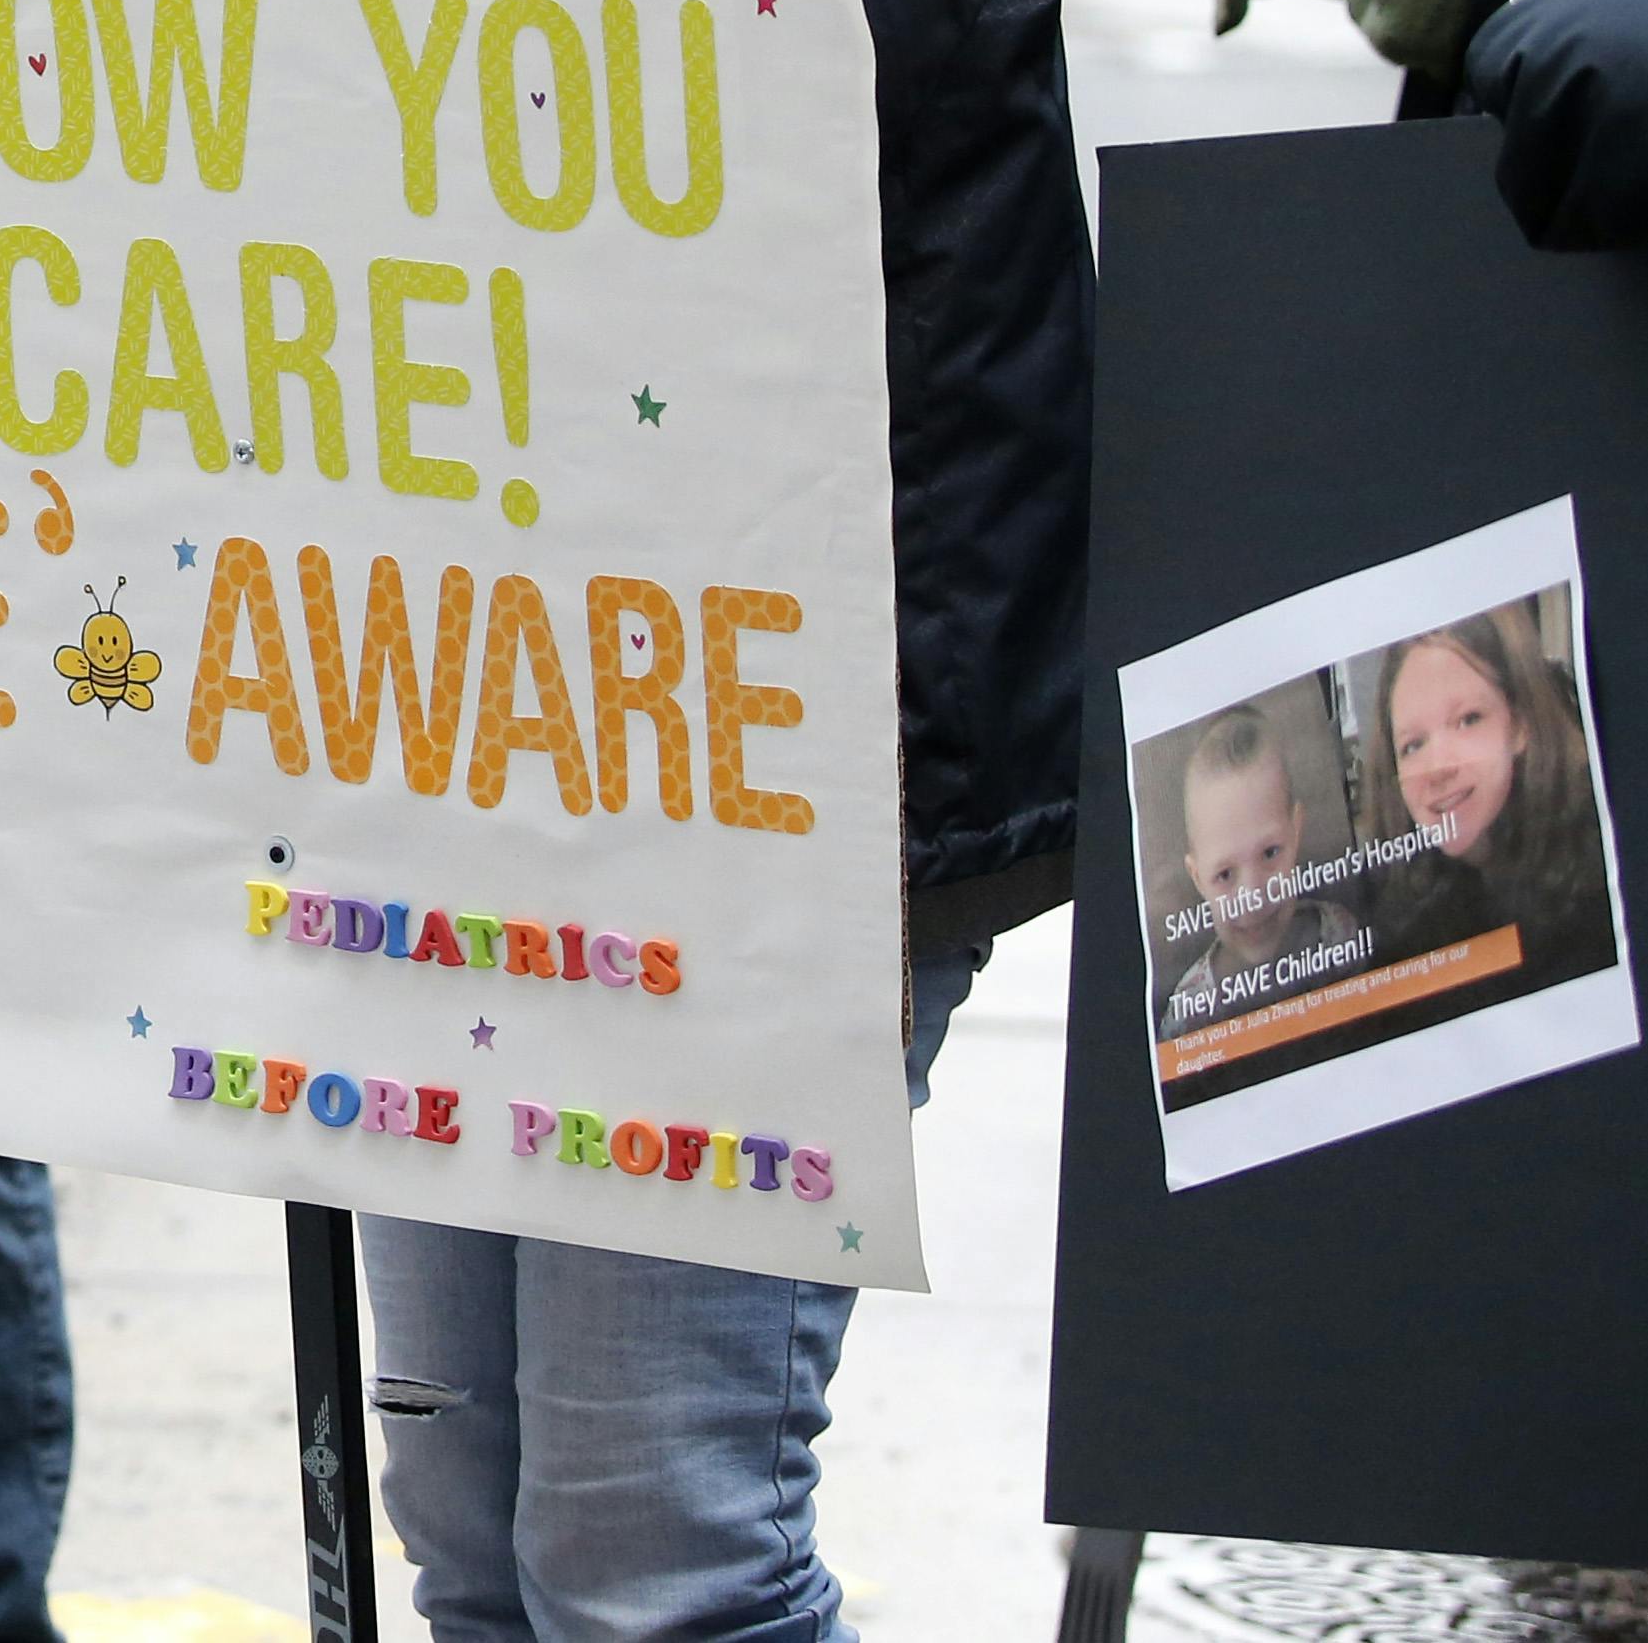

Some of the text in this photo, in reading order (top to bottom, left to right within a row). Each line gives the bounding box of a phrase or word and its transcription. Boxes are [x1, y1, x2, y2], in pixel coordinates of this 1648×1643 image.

[185, 536, 816, 835] AWARE
[244, 880, 682, 995] PEDIATRICS
[1165, 811, 1458, 942] SAVE Tufts Children's Hospital!
[1169, 926, 1374, 1021] They SAVE Children!!
[1173, 1035, 1205, 1054] Thank
[1206, 1026, 1228, 1046] you
[1369, 967, 1392, 987] and
[1393, 957, 1429, 982] caring
[1430, 950, 1447, 968] for
[167, 1045, 834, 1202] BEFORE PROFITS
